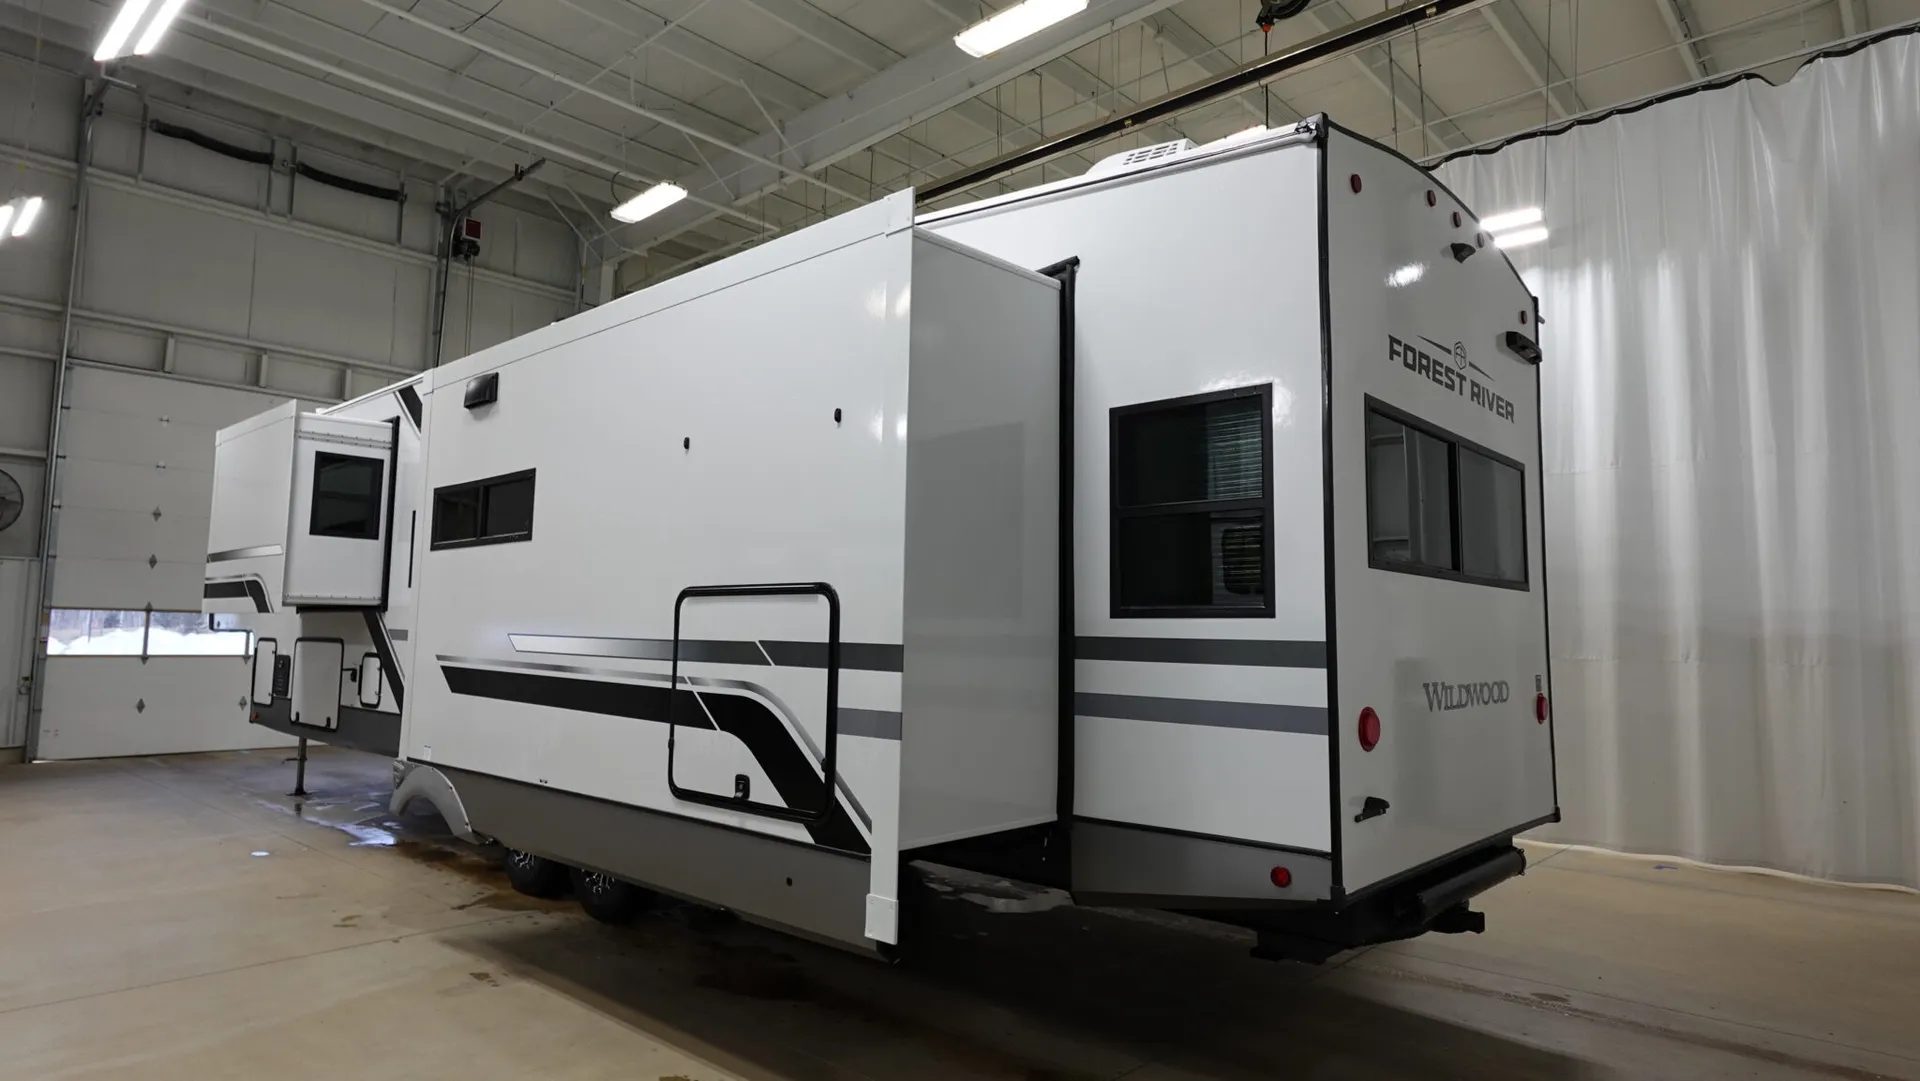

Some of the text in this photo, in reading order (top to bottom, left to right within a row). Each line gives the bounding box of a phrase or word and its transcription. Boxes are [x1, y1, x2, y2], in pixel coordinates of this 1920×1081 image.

[1388, 334, 1515, 424] FOREST RIVER
[1423, 680, 1510, 713] WILDWOOD
